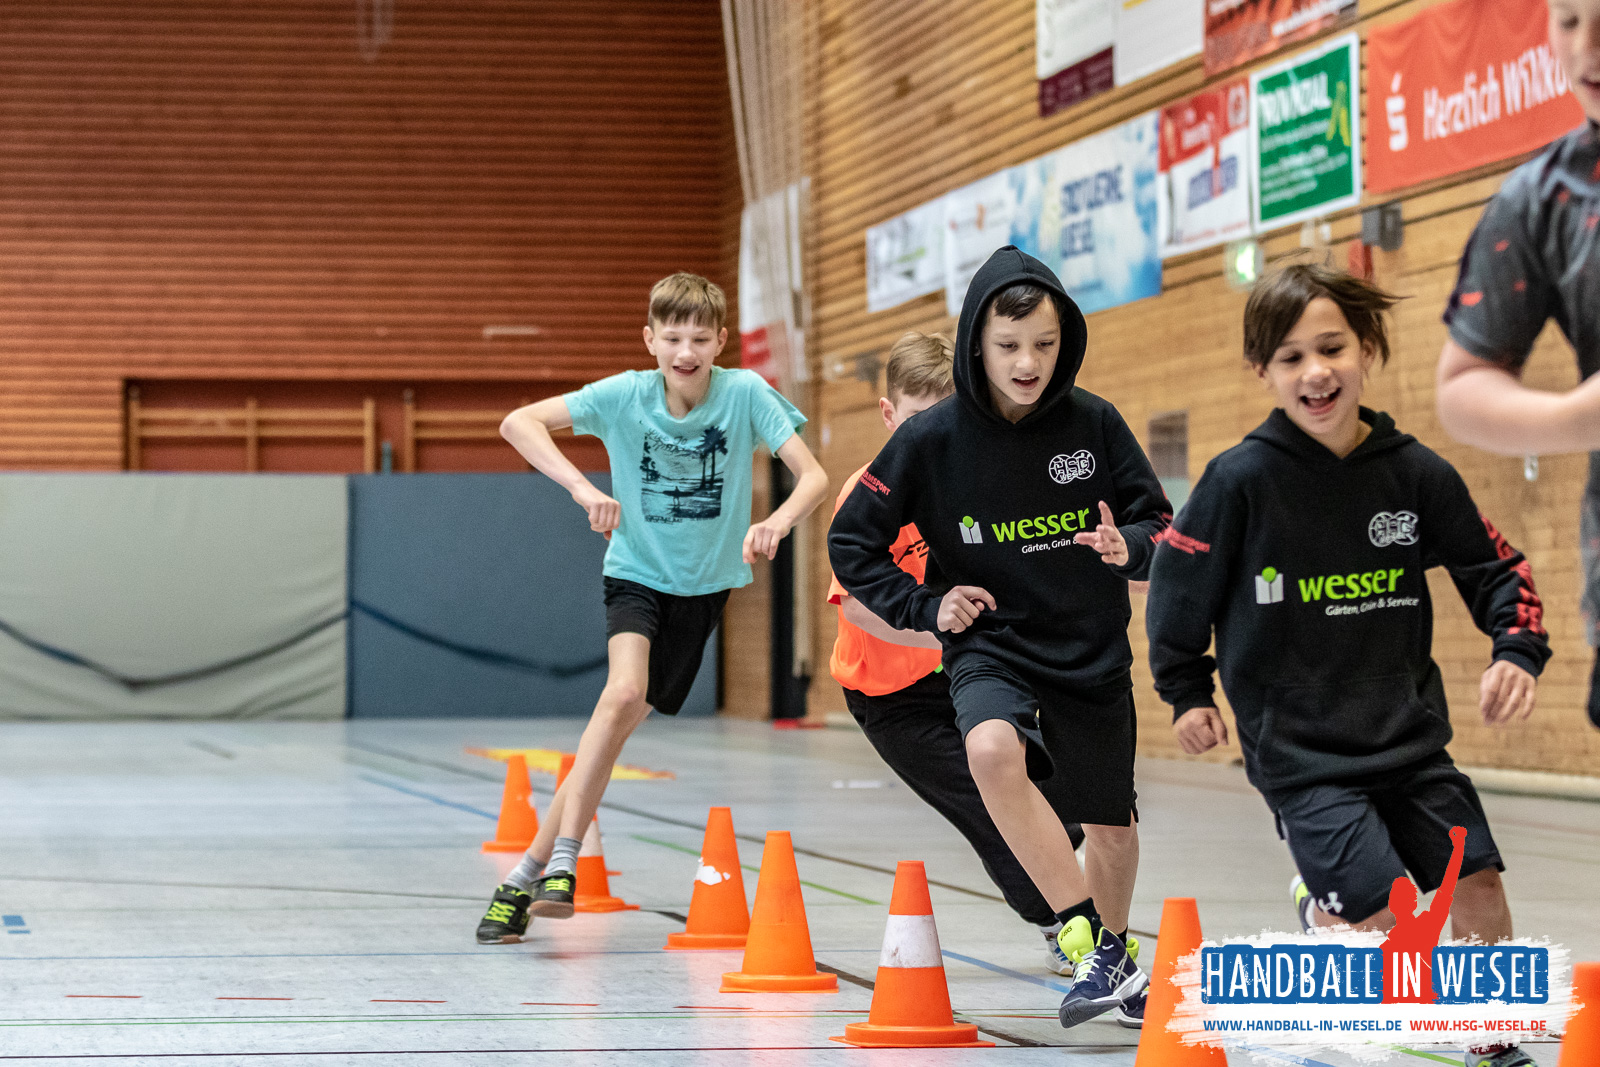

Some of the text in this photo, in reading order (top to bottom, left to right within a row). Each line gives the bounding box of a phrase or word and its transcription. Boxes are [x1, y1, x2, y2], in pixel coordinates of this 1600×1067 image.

[1423, 63, 1501, 141] Herzlich
[991, 508, 1090, 543] wesser
[1021, 543, 1051, 554] Gärten,
[1051, 538, 1071, 549] Grün
[1298, 568, 1404, 603] wesser
